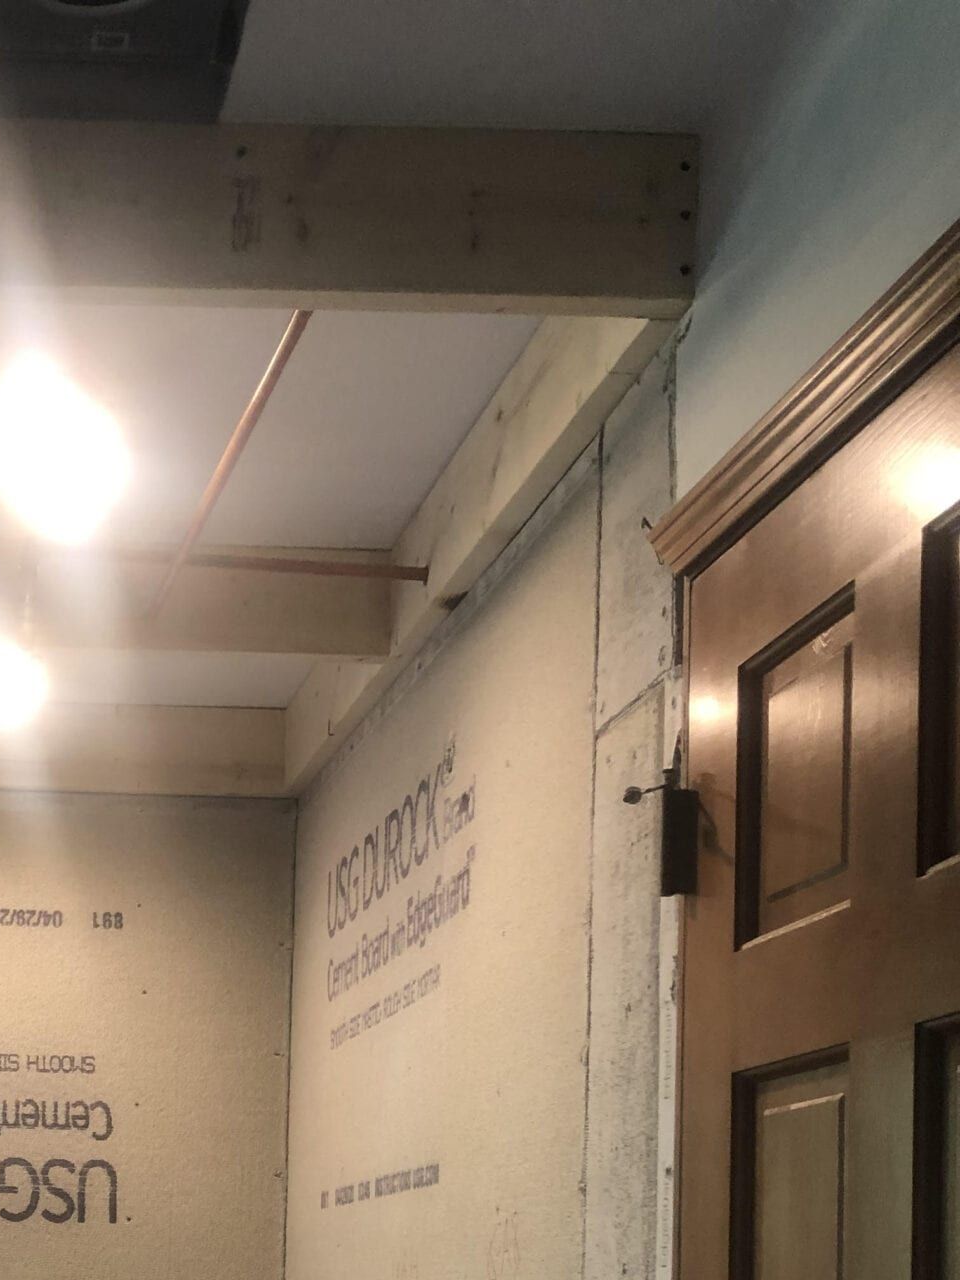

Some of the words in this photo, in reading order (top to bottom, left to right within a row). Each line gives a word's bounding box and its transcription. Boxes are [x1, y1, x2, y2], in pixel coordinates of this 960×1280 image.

[327, 845, 359, 938] USG
[362, 763, 440, 909] DUROCK
[328, 948, 359, 1002] Cement
[361, 916, 389, 979] Board
[26, 1055, 96, 1074] SMOOTH
